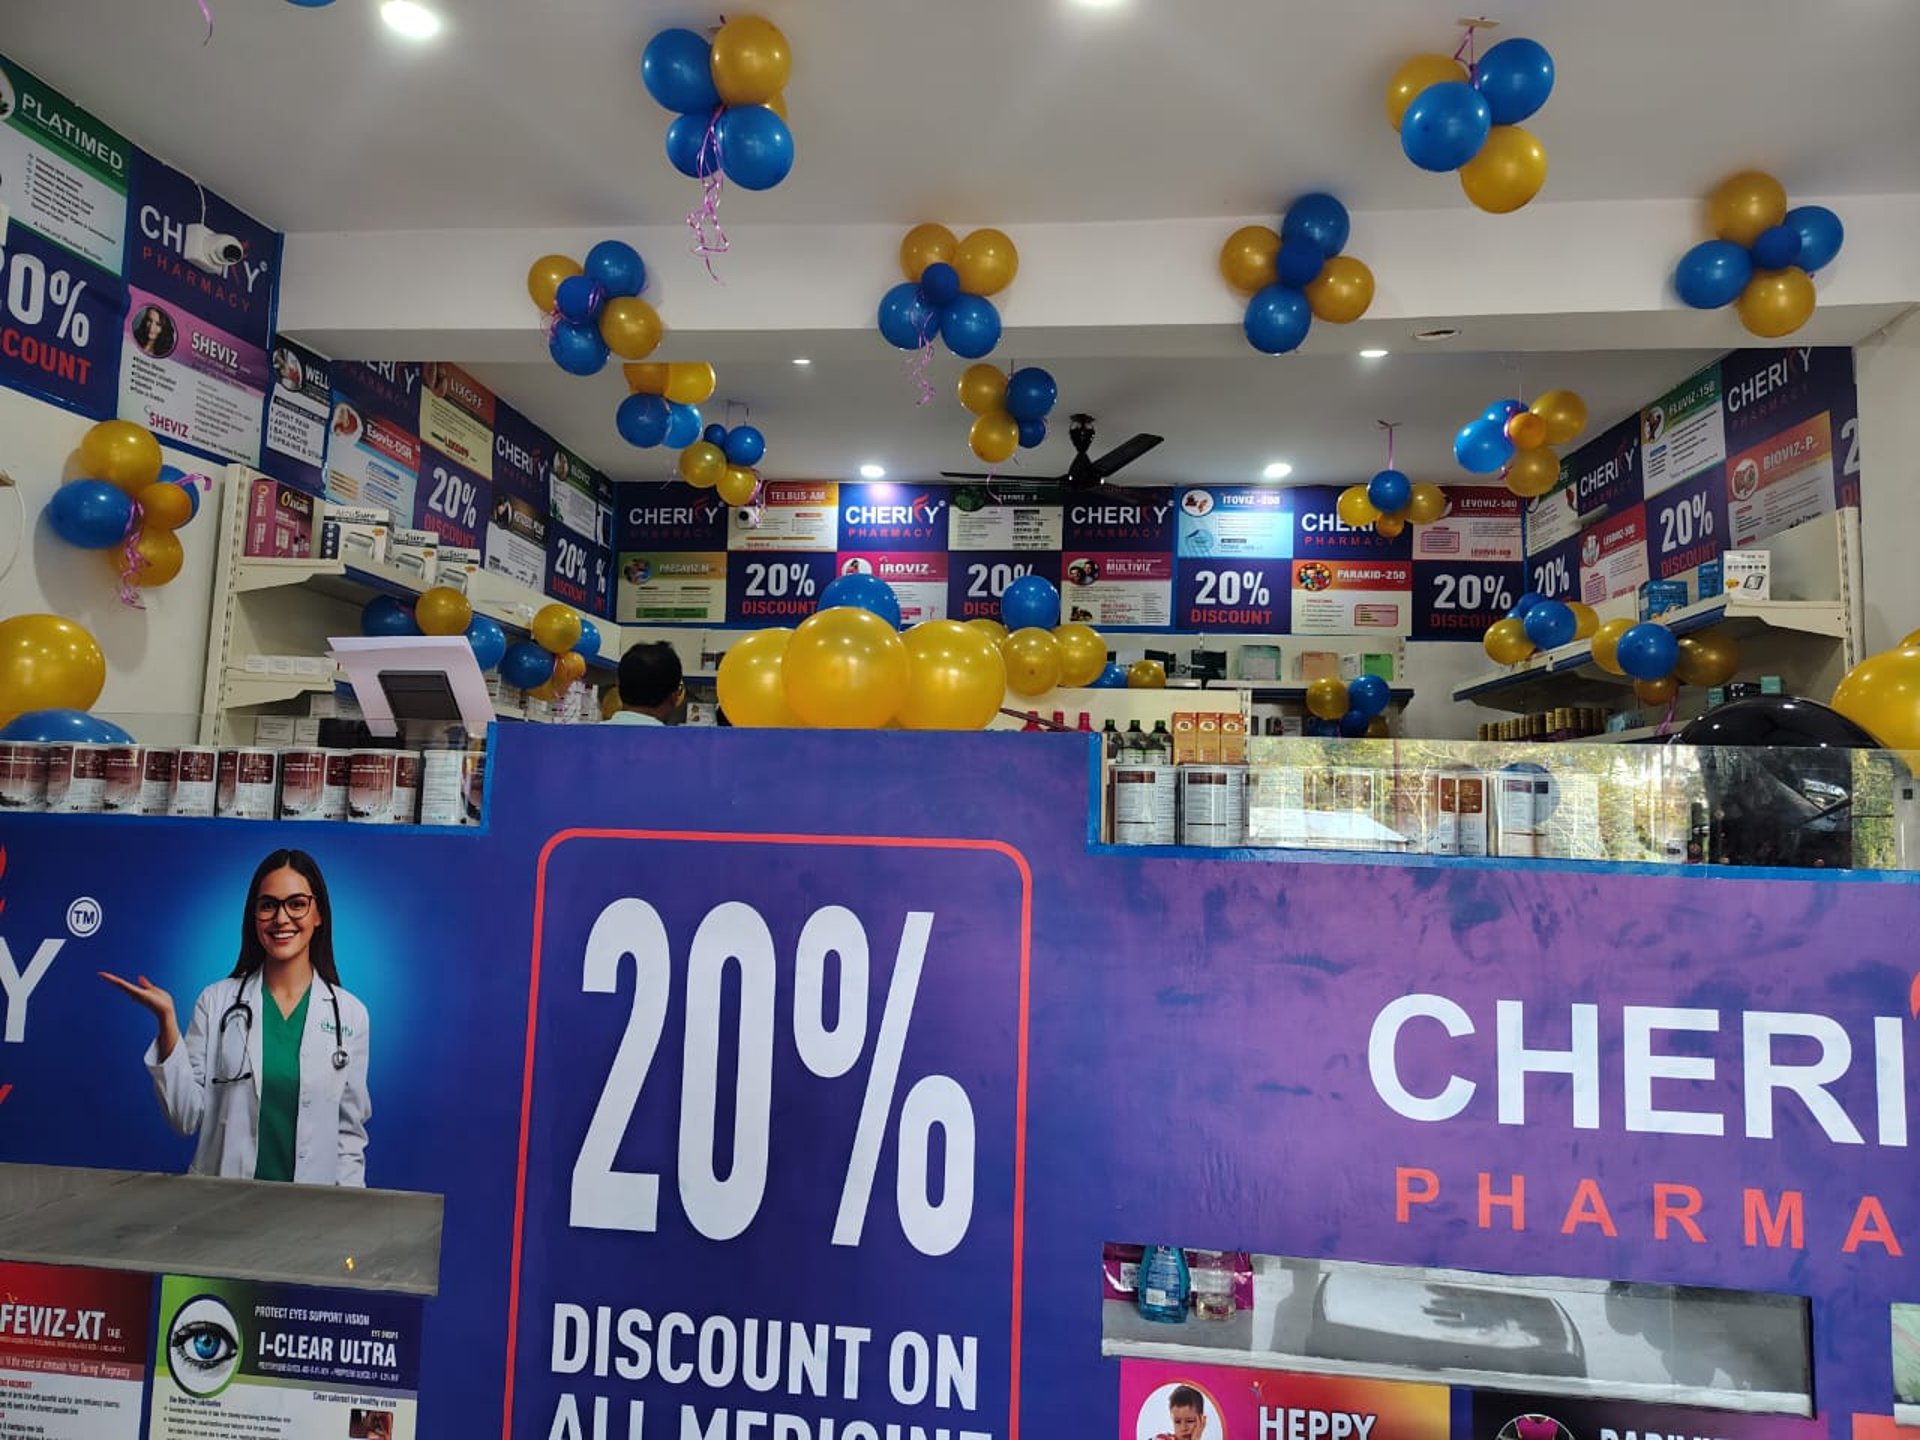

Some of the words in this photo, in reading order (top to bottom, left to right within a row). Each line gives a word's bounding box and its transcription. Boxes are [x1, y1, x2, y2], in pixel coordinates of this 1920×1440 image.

[22, 92, 124, 171] PLATIMED
[143, 245, 249, 313] PHARMACY
[192, 331, 239, 368] SHEVIZ
[149, 412, 189, 438] SHEVIZ
[1763, 436, 1814, 471] BIOVIZ-P
[428, 467, 477, 528] 20%
[423, 513, 476, 549] DISCOUNT
[848, 529, 933, 538] PHARMACY
[1073, 529, 1162, 538] PHARMACY
[1660, 491, 1714, 553] 20%
[555, 538, 587, 585] 20%
[879, 563, 929, 574] IROVIZ
[1106, 563, 1152, 572] MULTIVIZ
[1534, 553, 1570, 598] 20%
[1660, 540, 1717, 578] DISCOUNT
[745, 563, 815, 597] 20%
[1195, 570, 1270, 605] 20%
[1433, 574, 1511, 609] 20%
[742, 601, 817, 615] DISCOUNT
[1191, 608, 1272, 624] DISCOUNT
[569, 897, 976, 1257] 20%
[1395, 1166, 1904, 1258] PHARMA
[0, 1303, 105, 1342] FEVIZ-XT
[254, 1305, 288, 1319] PROTECT
[289, 1308, 308, 1321] EYES
[308, 1310, 343, 1324] SUPPORT
[344, 1312, 370, 1326] VISION
[259, 1331, 334, 1362] I-CLEAR
[340, 1338, 397, 1368] ULTRA
[551, 1302, 871, 1400] DISCOUNT
[888, 1330, 977, 1411] ON
